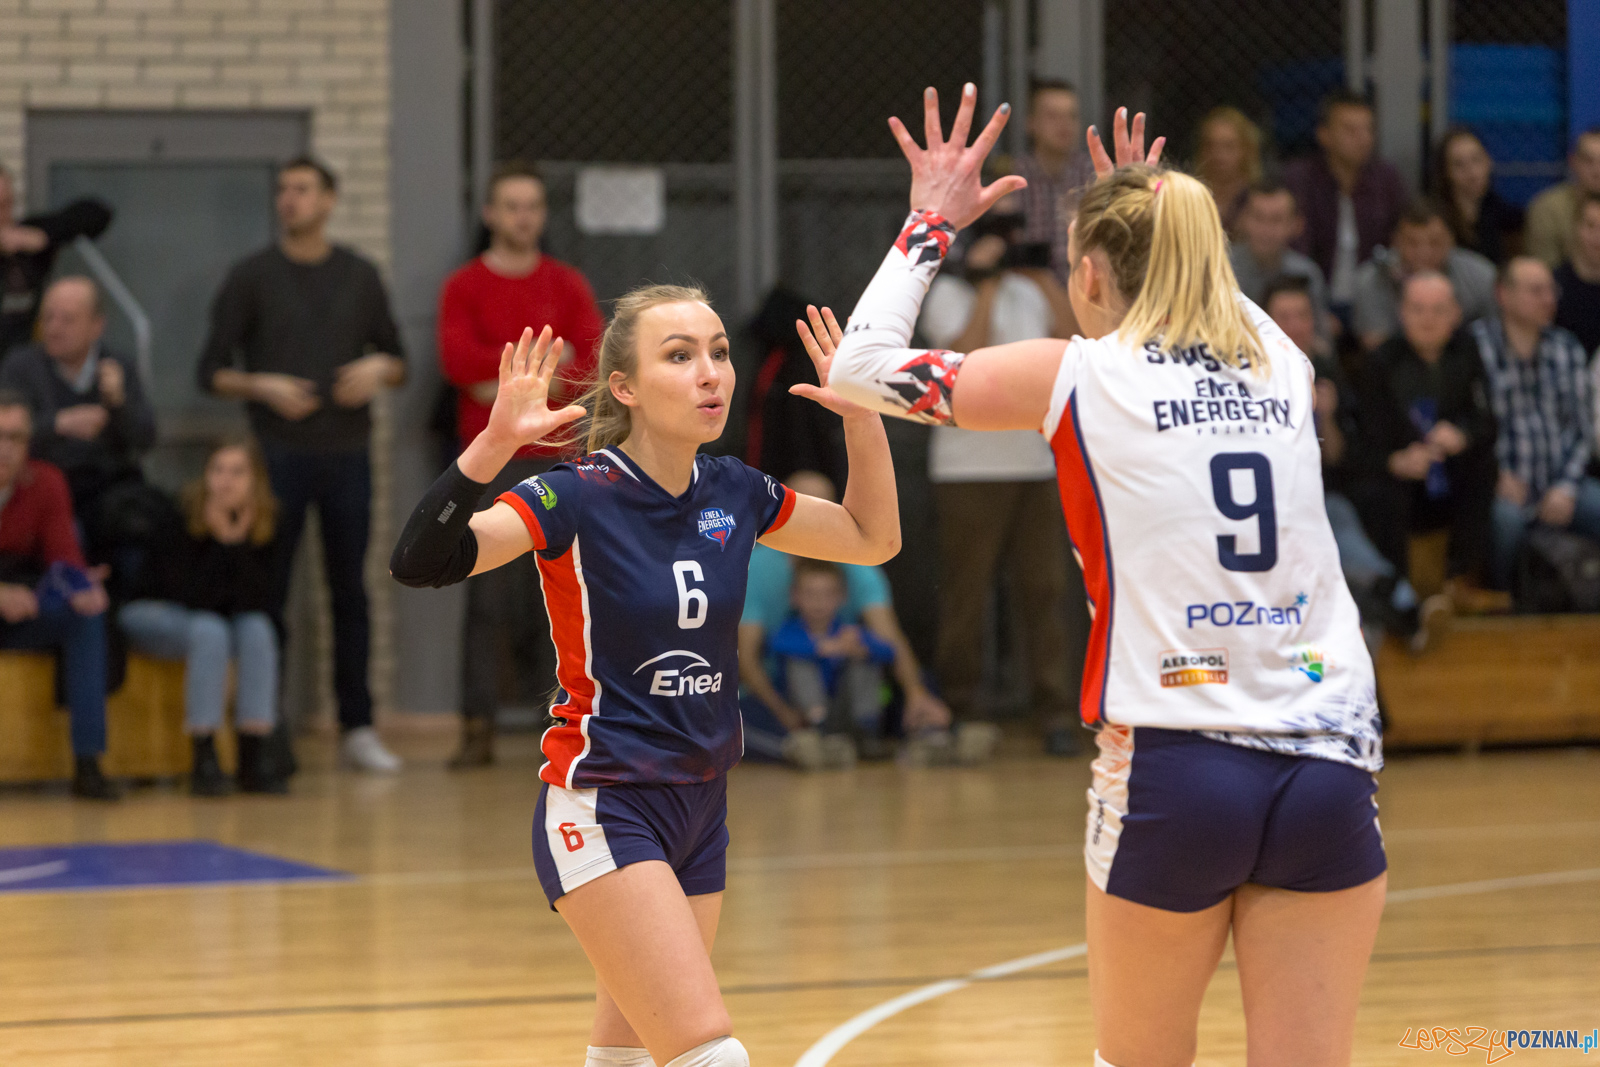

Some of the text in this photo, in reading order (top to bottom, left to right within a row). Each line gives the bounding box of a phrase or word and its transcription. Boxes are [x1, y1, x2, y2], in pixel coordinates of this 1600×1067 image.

[1194, 377, 1252, 400] ENEA
[697, 514, 736, 533] ENERGETYK
[704, 510, 721, 520] ENEA
[1209, 451, 1279, 573] 9
[672, 560, 709, 630] 6
[649, 669, 723, 697] Enea
[558, 822, 585, 853] 6
